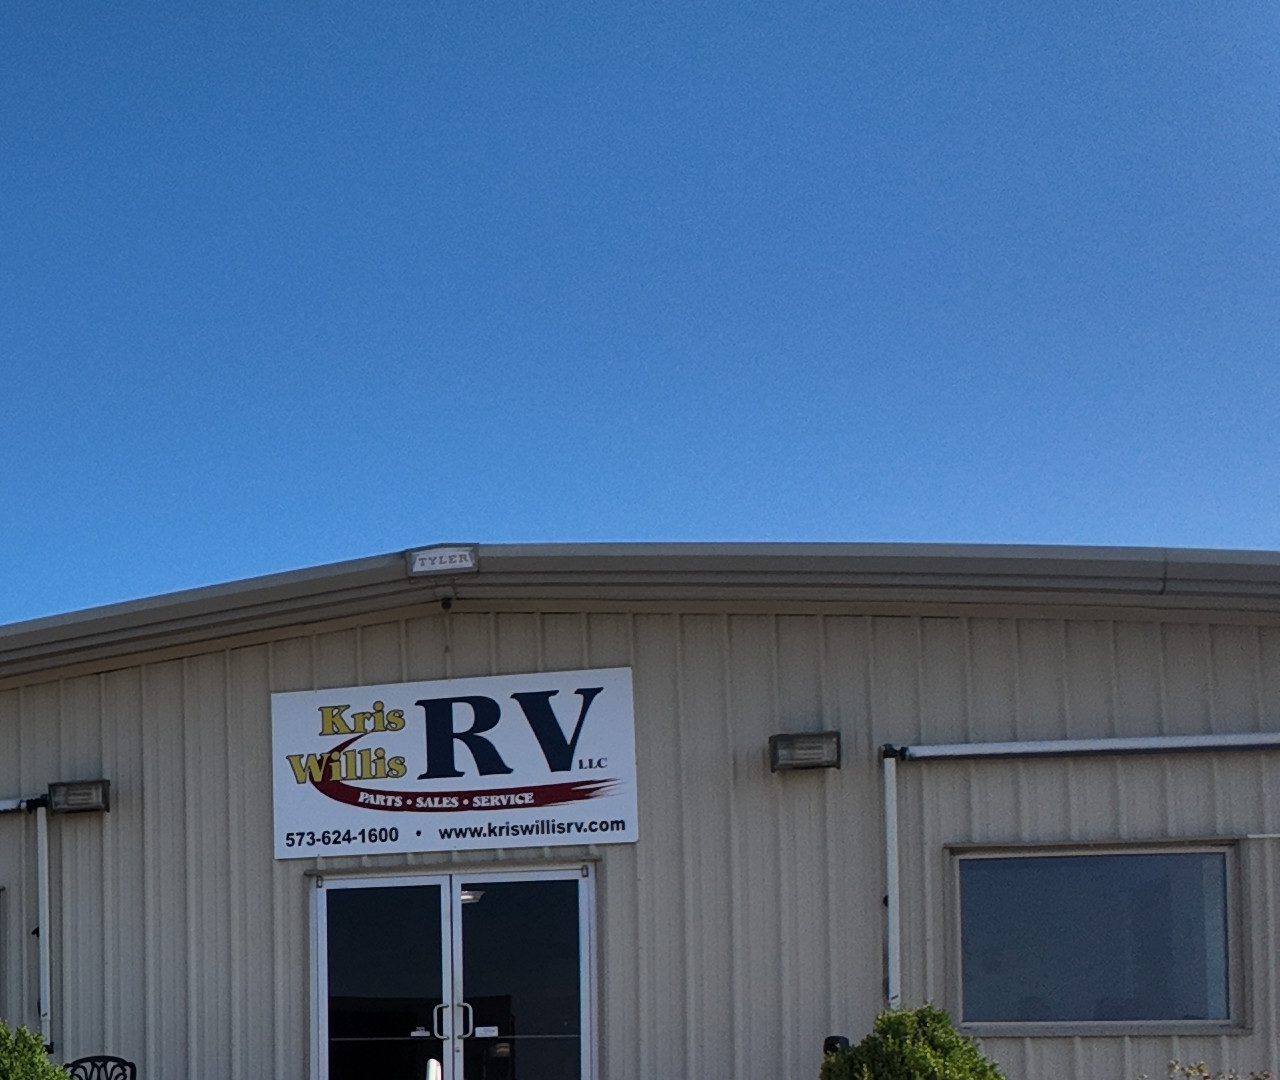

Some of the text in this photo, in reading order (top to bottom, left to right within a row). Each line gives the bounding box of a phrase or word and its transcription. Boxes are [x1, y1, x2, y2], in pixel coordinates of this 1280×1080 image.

[418, 553, 469, 567] TYLER
[318, 700, 406, 736] Kris
[414, 687, 604, 780] RV
[285, 747, 407, 784] Willis
[578, 757, 608, 770] LLC
[358, 791, 535, 808] PARTS SALES SERVICE
[285, 819, 626, 847] 573-624-1600 www.kriswillisrv.com
